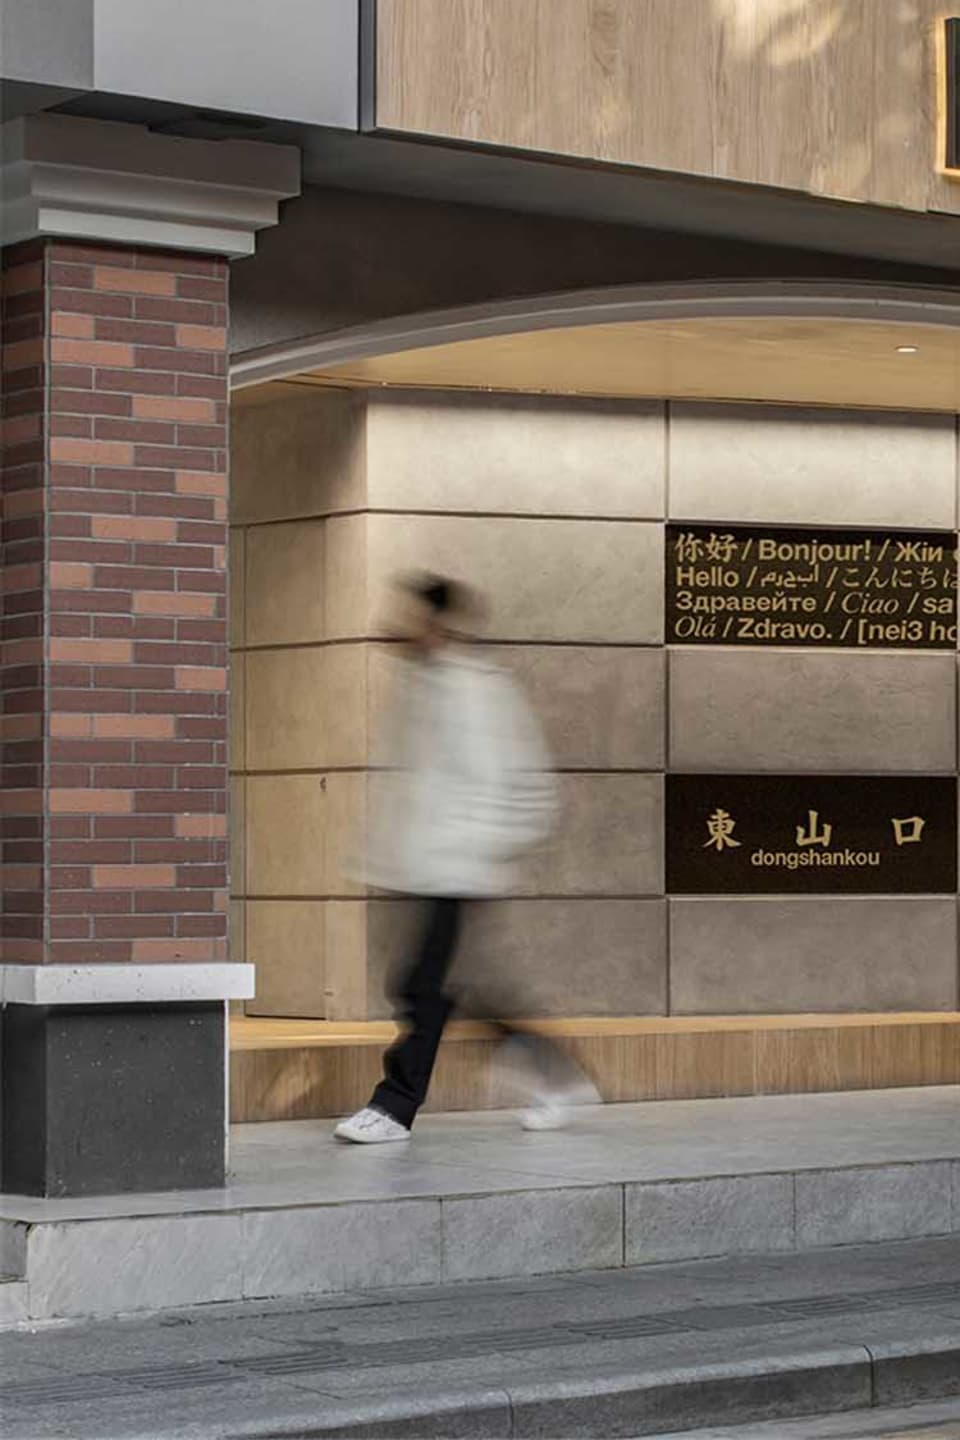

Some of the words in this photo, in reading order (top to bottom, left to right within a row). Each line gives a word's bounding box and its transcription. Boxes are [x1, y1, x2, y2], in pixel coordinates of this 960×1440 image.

[674, 532, 738, 563] 你好
[759, 539, 871, 566] Bonjour!
[676, 566, 740, 588] Hello
[676, 591, 817, 613] Здравейте
[841, 591, 899, 614] Ciao
[922, 597, 953, 614] sa
[675, 616, 716, 638] Olá
[858, 619, 922, 645] [nei3
[702, 808, 925, 851] 東山口
[750, 849, 881, 870] dongshankou
